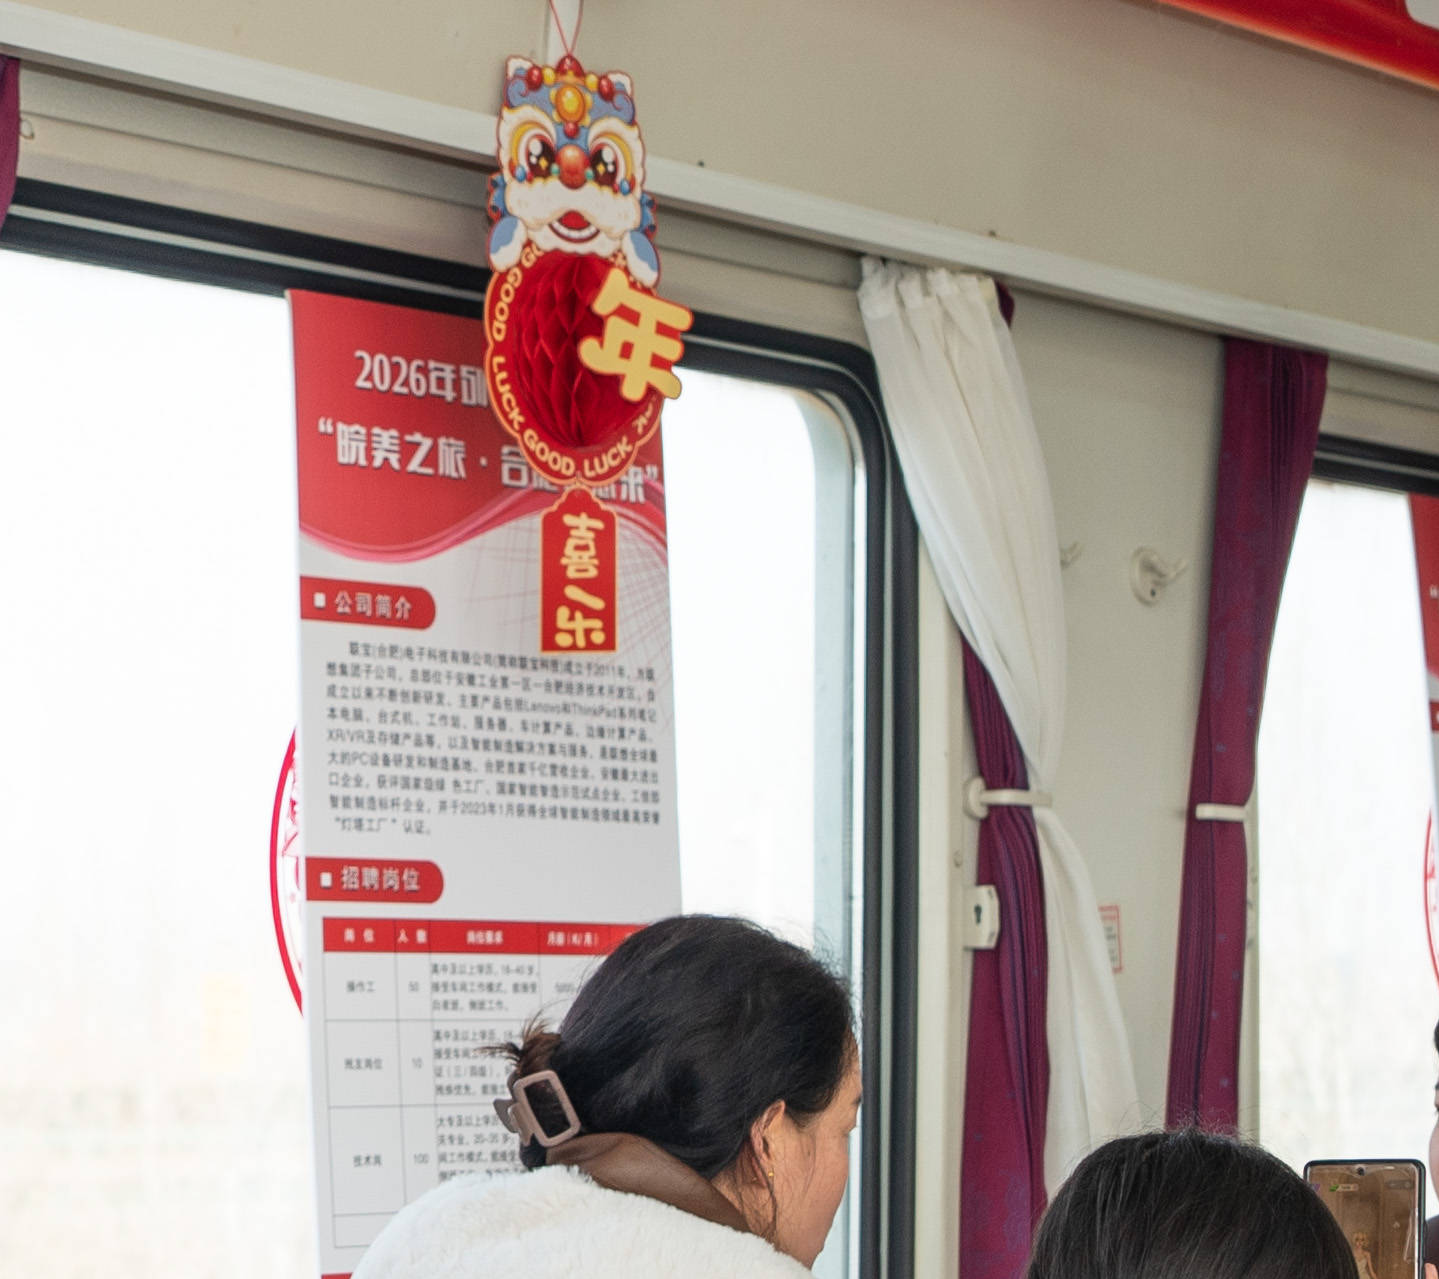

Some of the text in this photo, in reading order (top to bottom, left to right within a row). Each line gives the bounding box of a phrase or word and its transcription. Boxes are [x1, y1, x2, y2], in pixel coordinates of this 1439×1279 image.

[578, 267, 696, 402] 年
[334, 591, 413, 621] 公司简介
[555, 512, 606, 649] 喜乐
[341, 866, 421, 892] 招聘岗位
